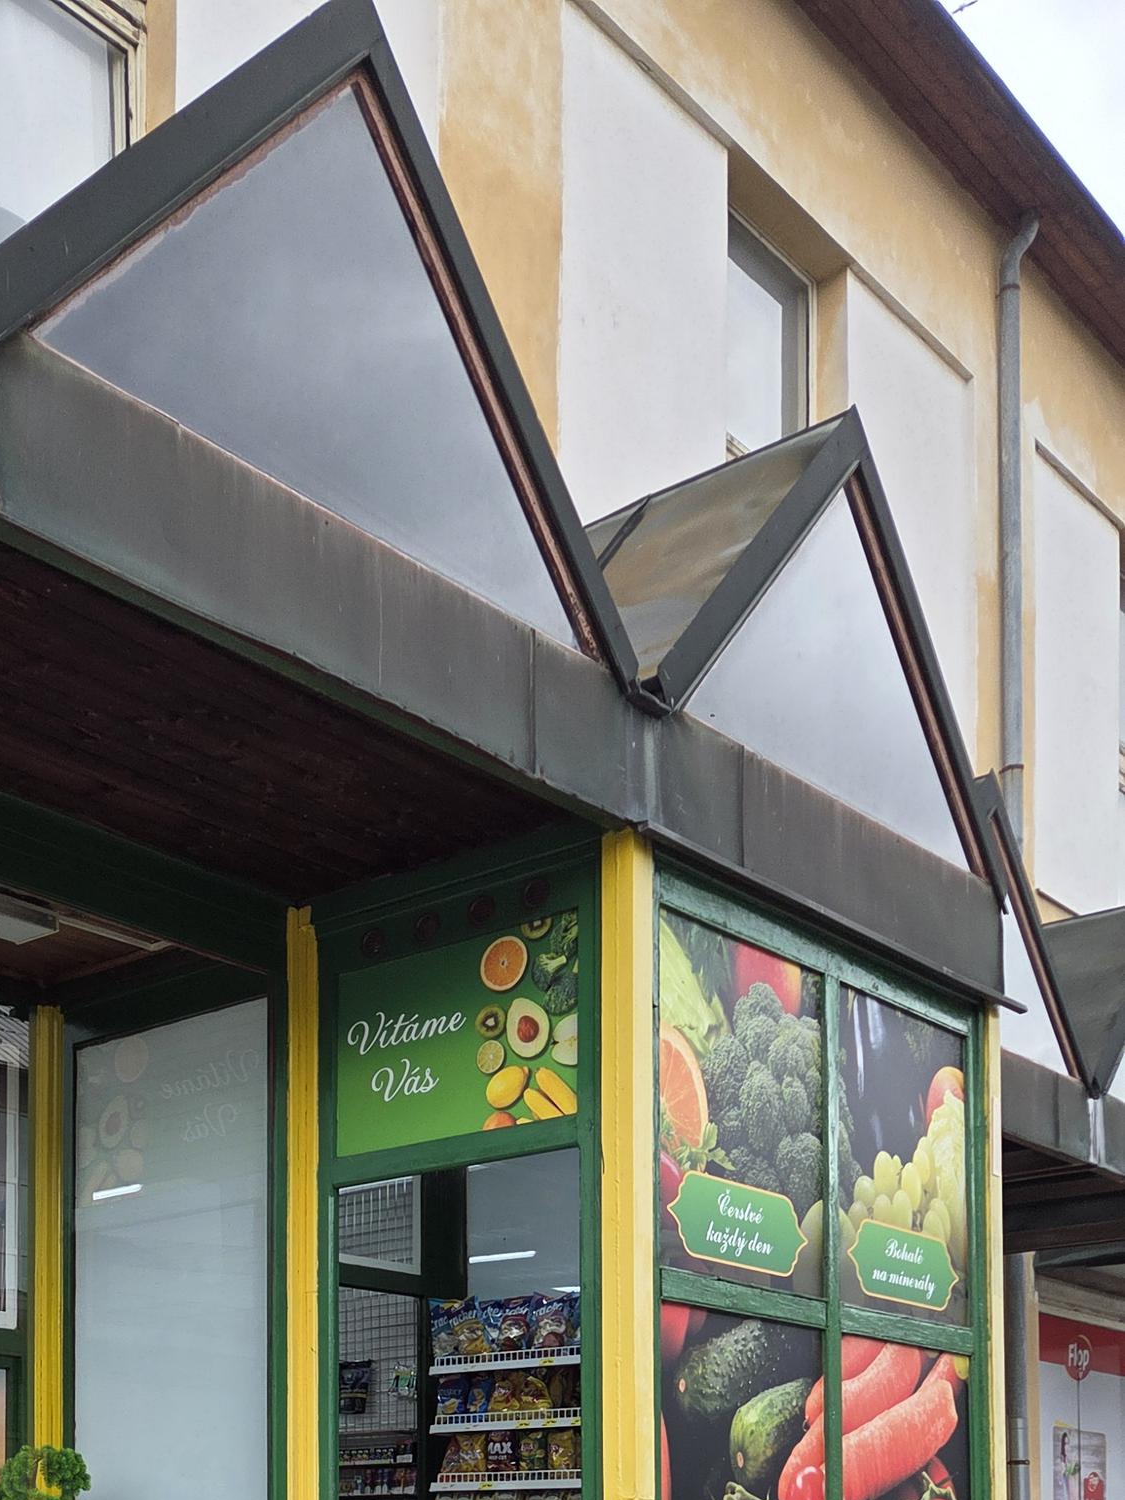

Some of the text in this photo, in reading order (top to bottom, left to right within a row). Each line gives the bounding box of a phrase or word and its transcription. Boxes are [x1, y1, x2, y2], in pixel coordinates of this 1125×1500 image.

[347, 1011, 467, 1056] Vítáme
[371, 1058, 440, 1102] Vás
[717, 1189, 764, 1225] Čerstvé
[706, 1221, 774, 1257] každý den
[884, 1238, 924, 1265] Bohaté
[872, 1268, 936, 1300] na minerály
